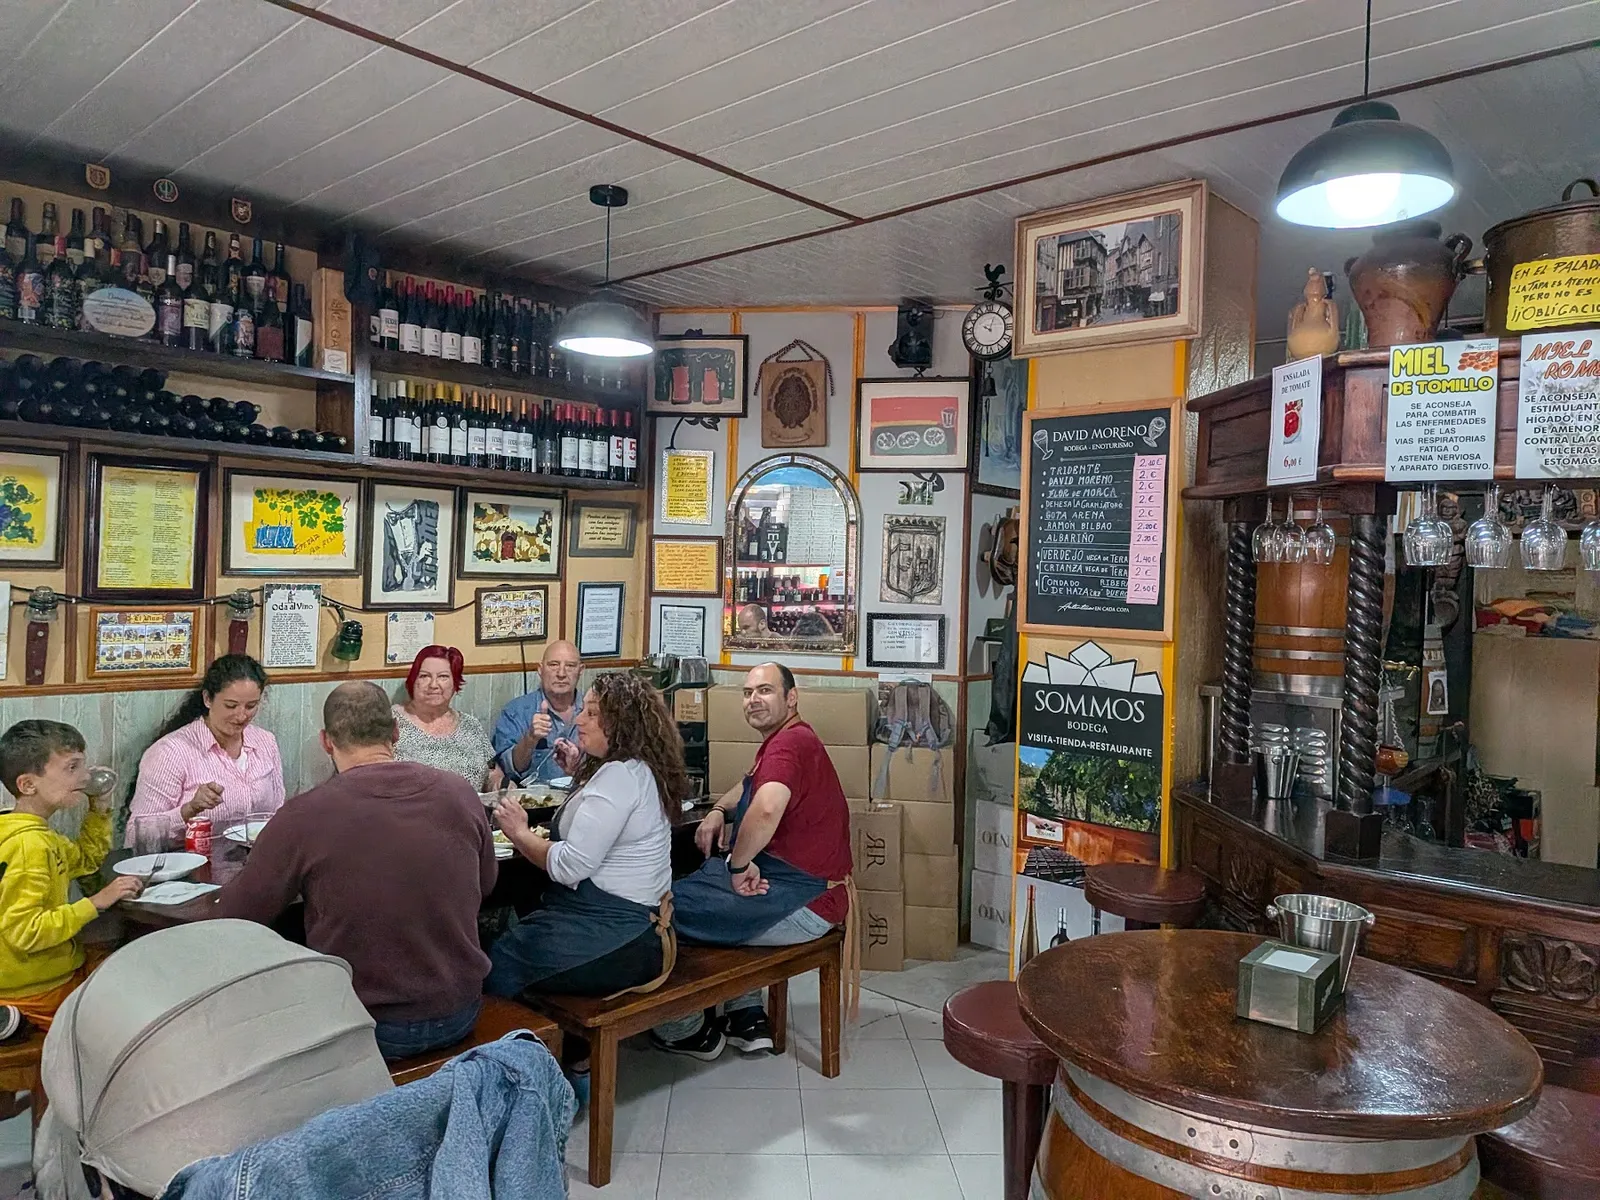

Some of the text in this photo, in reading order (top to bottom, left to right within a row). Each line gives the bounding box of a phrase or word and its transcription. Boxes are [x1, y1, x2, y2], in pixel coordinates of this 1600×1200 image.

[1514, 259, 1600, 280] EN EL PALAD
[1528, 280, 1548, 291] TAPA
[1522, 292, 1550, 303] PERO
[1576, 288, 1592, 296] ES
[1525, 340, 1592, 362] MIEL
[1392, 346, 1449, 378] MIEL
[1282, 368, 1310, 382] ENSALADA
[1282, 380, 1310, 394] DE TOMATE
[1391, 376, 1494, 396] DE TOMILLO
[1540, 392, 1597, 402] ACONSEJA
[1426, 400, 1472, 408] ACONSEJA
[1432, 409, 1476, 417] COMBATIR
[1416, 418, 1486, 426] ENFERMEDADES
[1053, 425, 1147, 442] DAVID MORENO
[1418, 435, 1486, 444] RESPIRATORIAS
[1524, 436, 1568, 444] CONTRA
[1092, 442, 1134, 450] ENOTURISMO
[1050, 464, 1100, 474] TRIDENTE
[1049, 475, 1113, 486] DAVID MORENO
[1083, 487, 1118, 498] MORCA
[1072, 510, 1105, 519] ARENA
[1082, 522, 1112, 530] BILBAO
[1046, 534, 1094, 543] ALBARIÑO
[1043, 550, 1084, 560] VERDEJO
[1110, 554, 1128, 563] TERA
[1110, 566, 1128, 576] TERA
[1042, 575, 1080, 592] CONDADO
[1066, 588, 1088, 596] HAZA
[289, 602, 296, 610] al
[1034, 690, 1145, 722] SOMMOS
[1067, 720, 1108, 734] BODEGA
